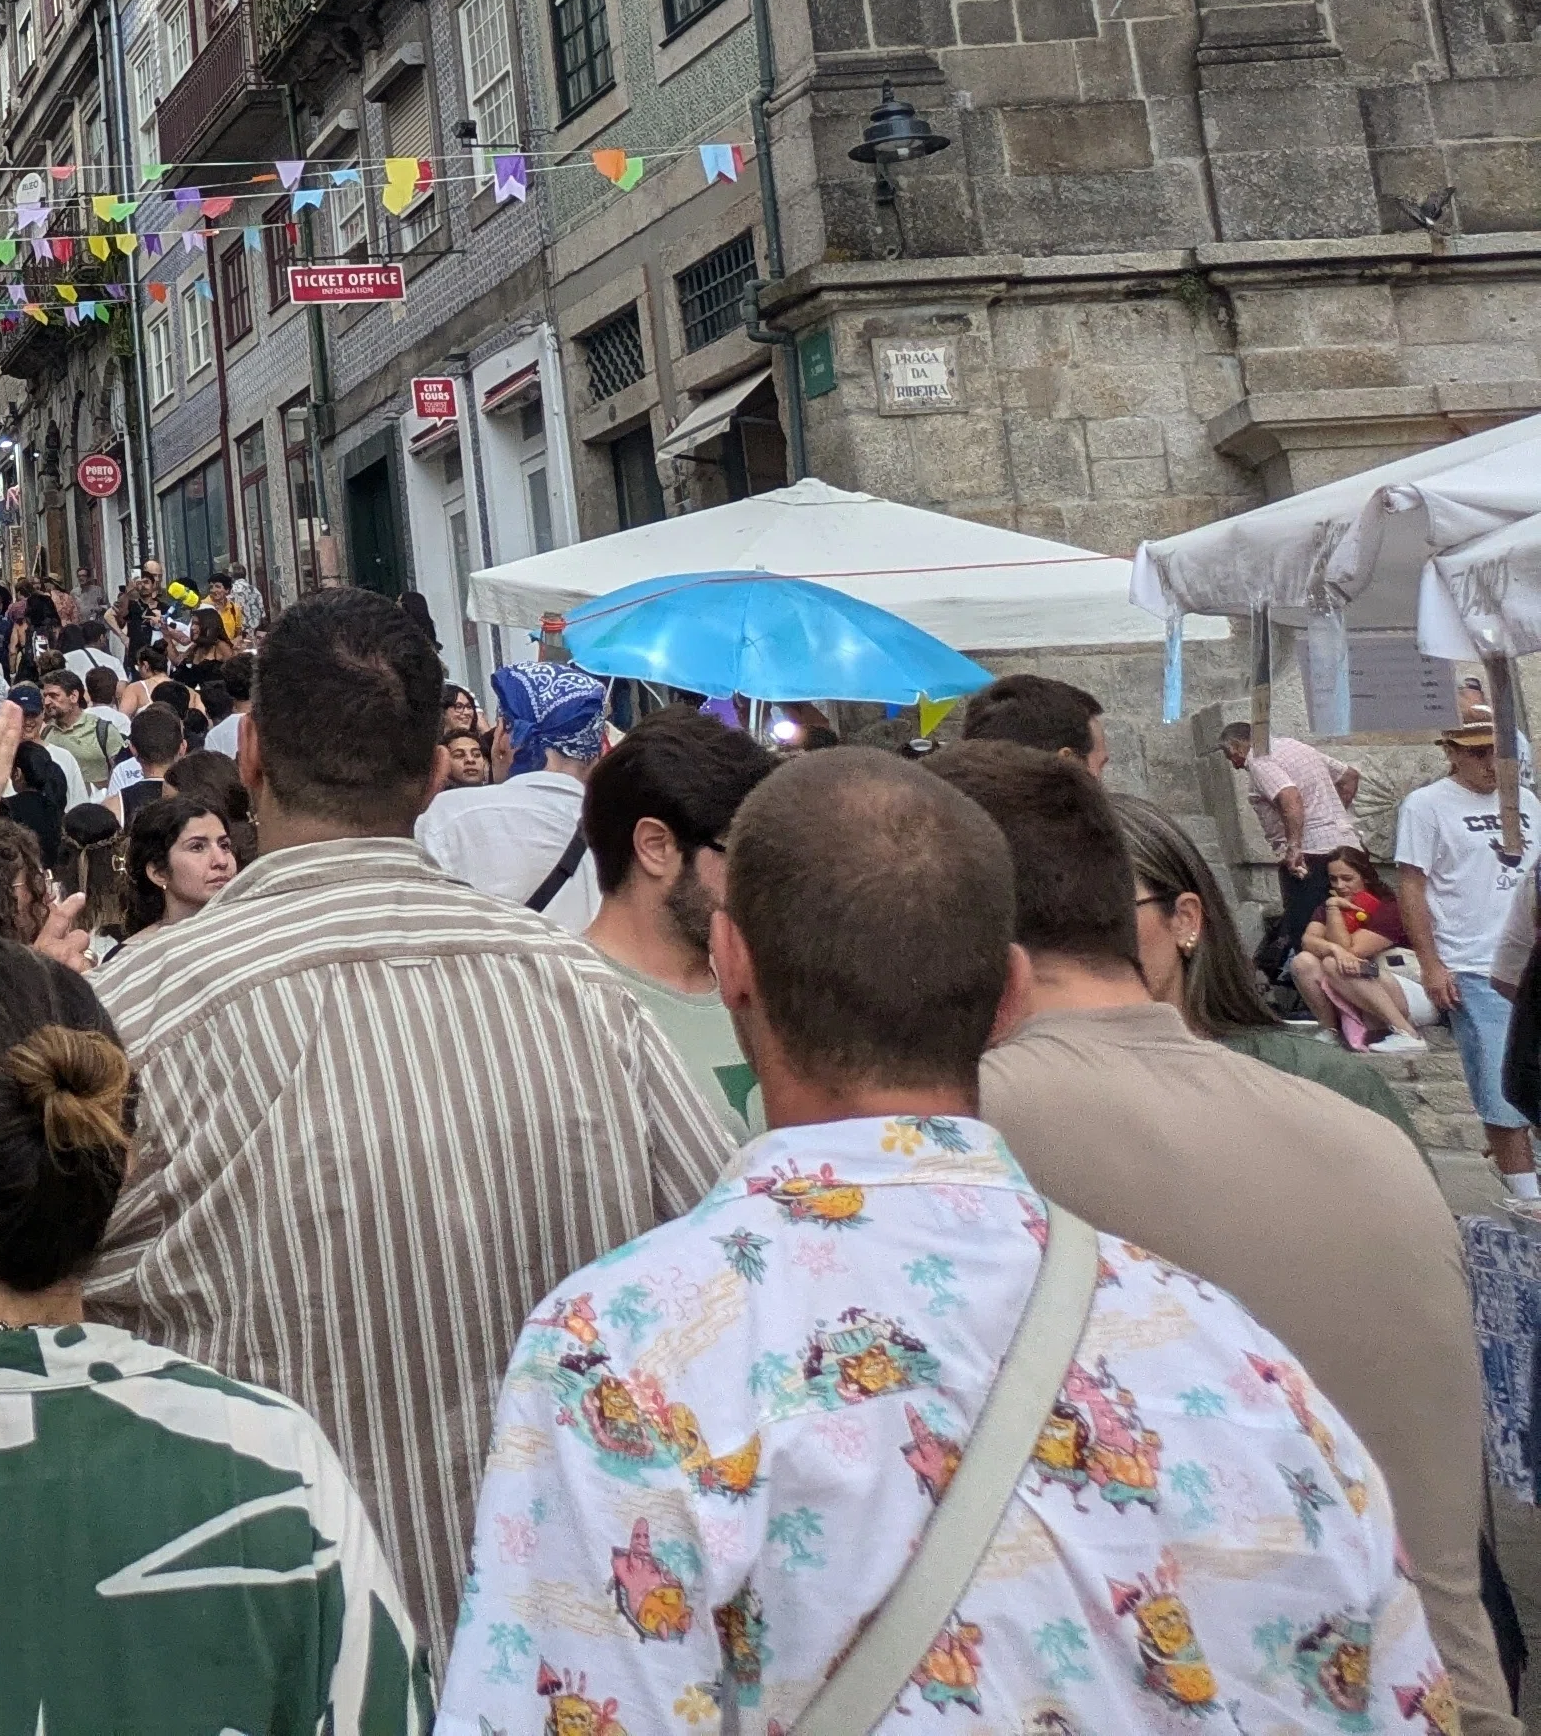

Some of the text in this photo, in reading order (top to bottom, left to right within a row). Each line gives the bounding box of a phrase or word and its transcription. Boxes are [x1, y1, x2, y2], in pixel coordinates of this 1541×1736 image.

[295, 272, 398, 288] TICKET OFFICE
[322, 287, 374, 295] INFORMATION
[911, 367, 929, 379] DA
[423, 383, 443, 392] CITY
[895, 384, 949, 398] RIBEIRA
[419, 391, 450, 401] TOURS
[86, 466, 114, 476] PORTO
